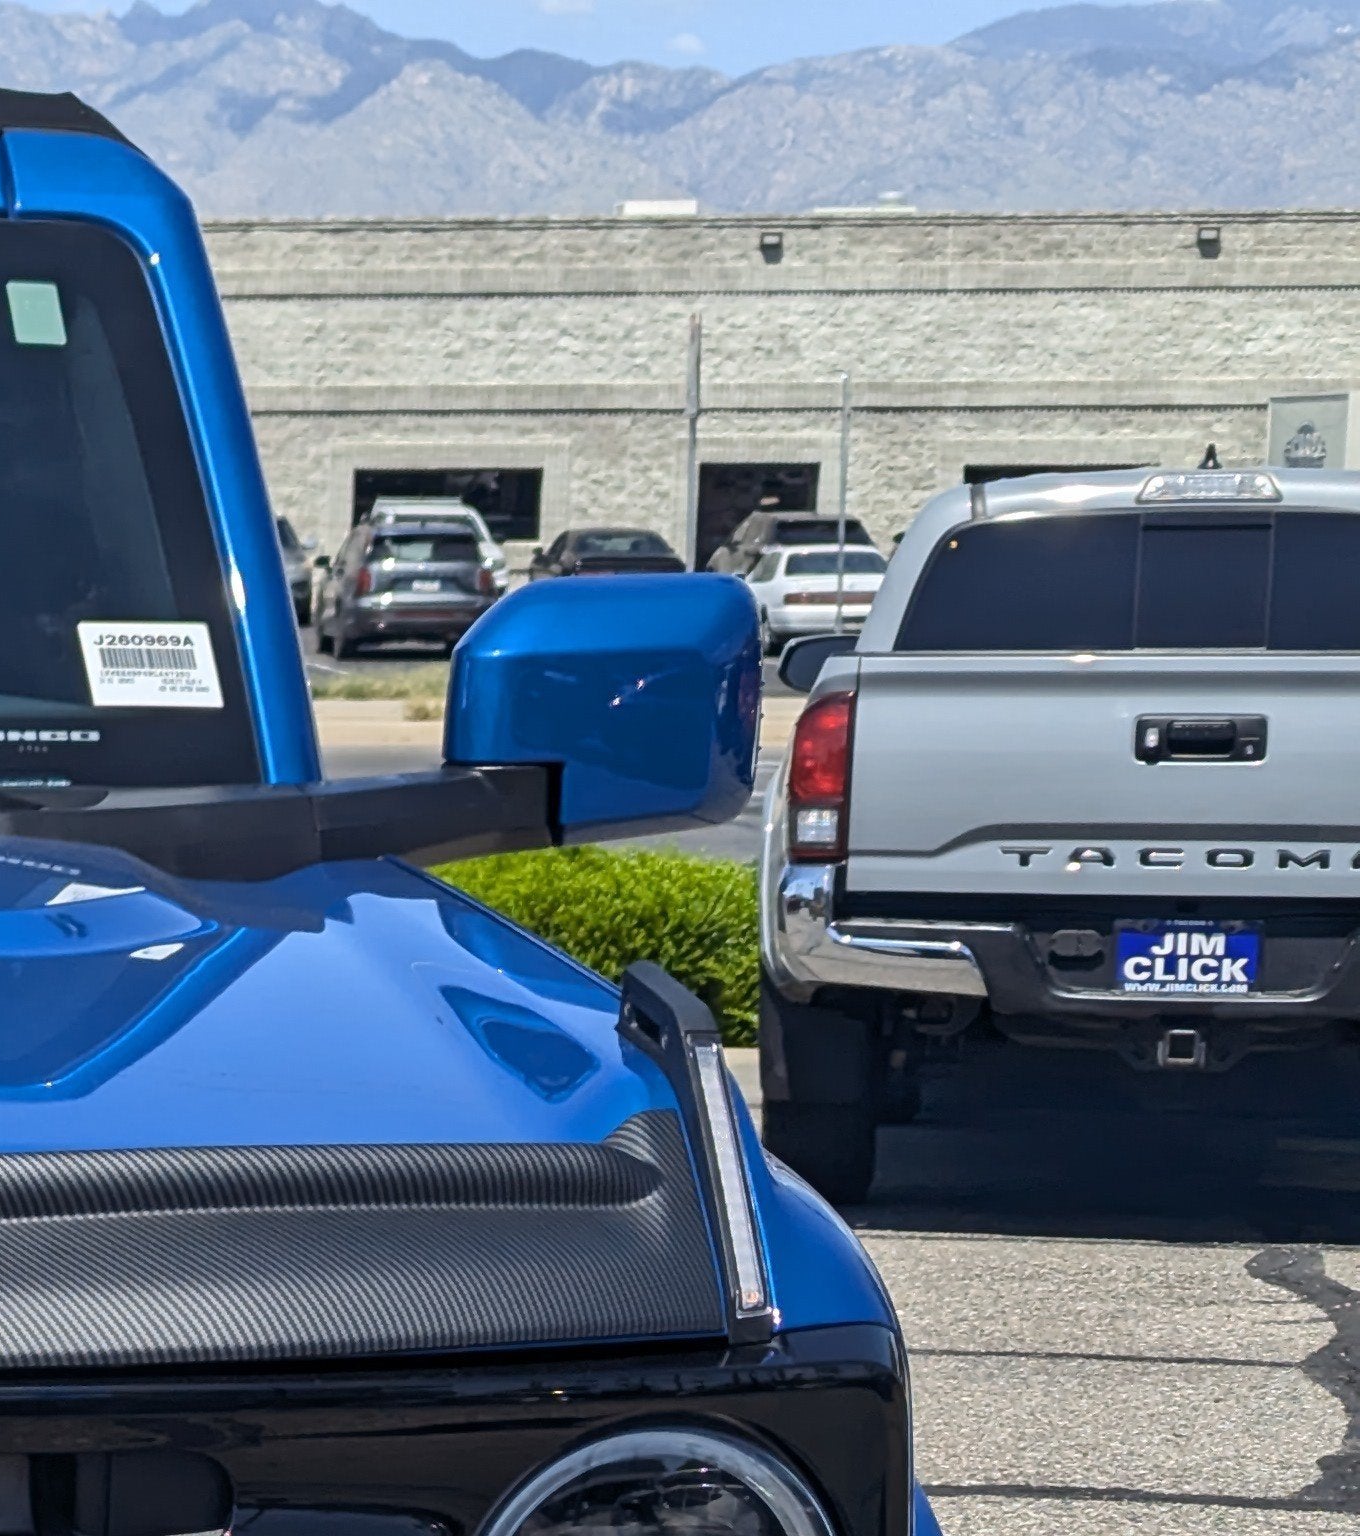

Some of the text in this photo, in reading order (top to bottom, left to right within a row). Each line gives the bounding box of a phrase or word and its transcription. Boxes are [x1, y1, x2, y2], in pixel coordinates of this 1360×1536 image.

[999, 846, 1360, 869] TACOM
[1150, 932, 1226, 955] JIM
[1123, 956, 1249, 982] CLICK
